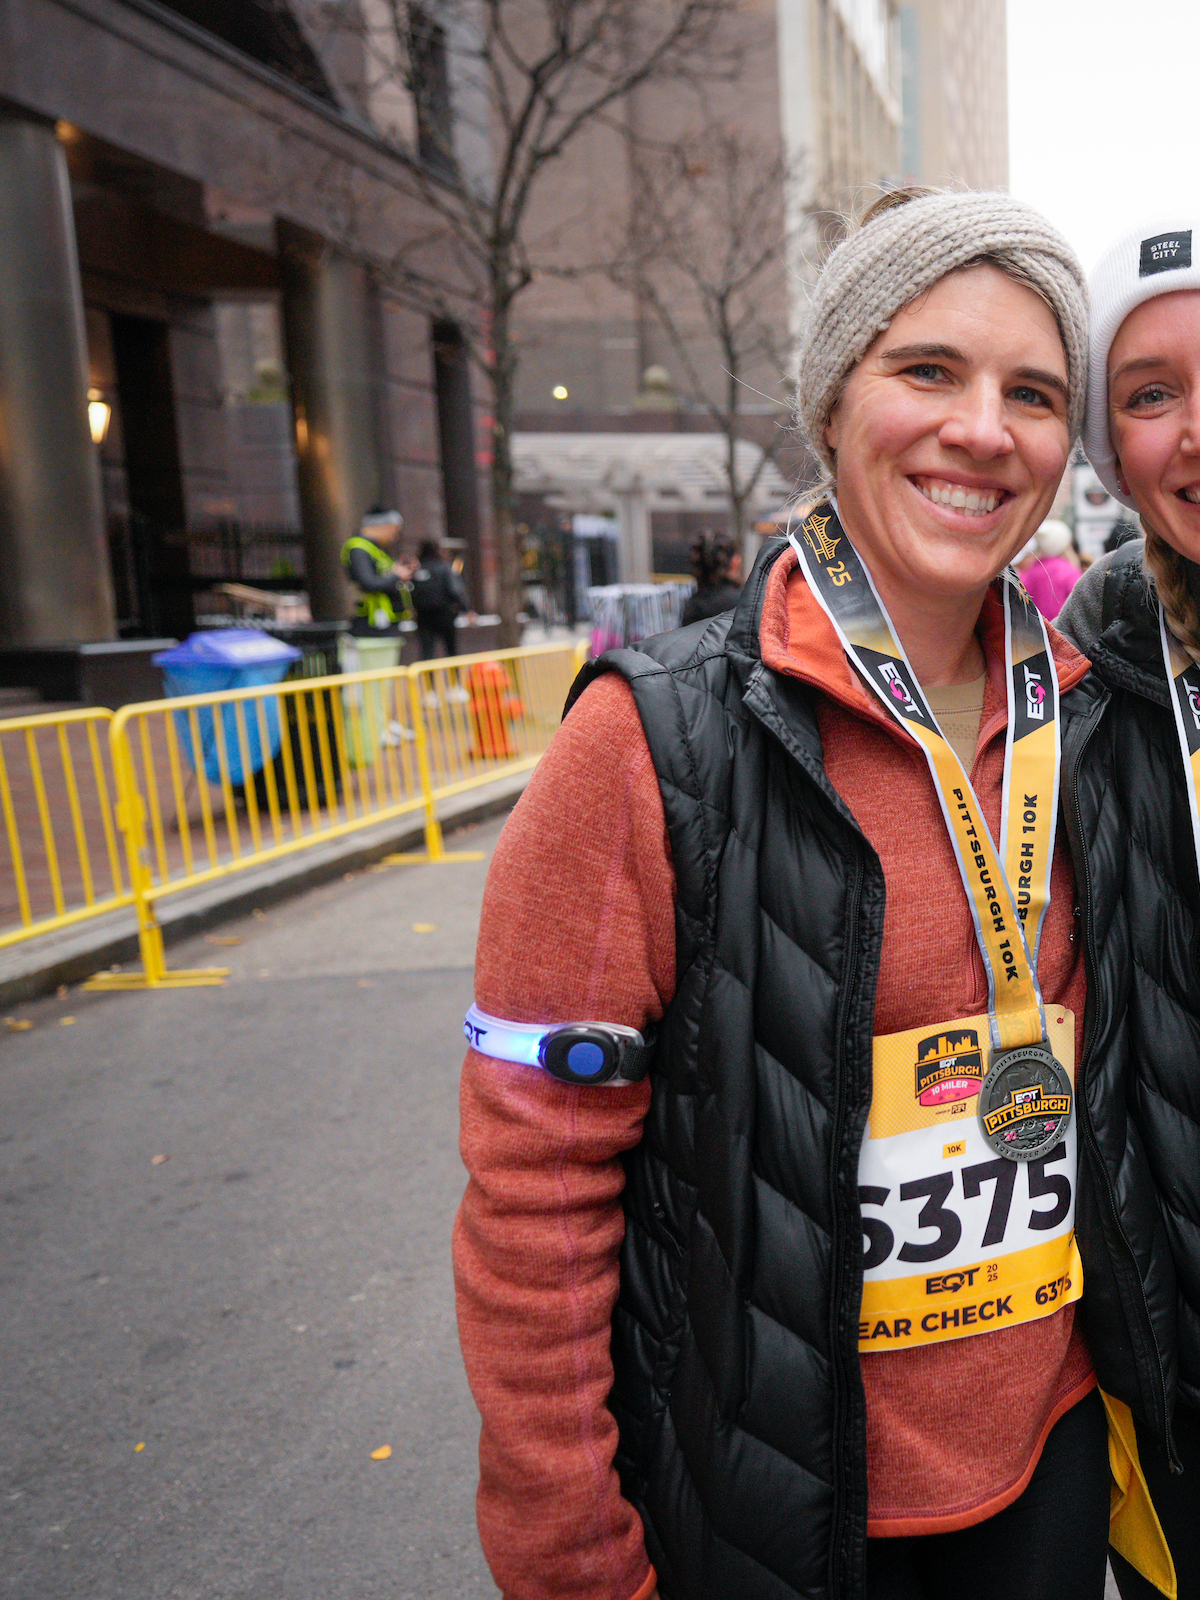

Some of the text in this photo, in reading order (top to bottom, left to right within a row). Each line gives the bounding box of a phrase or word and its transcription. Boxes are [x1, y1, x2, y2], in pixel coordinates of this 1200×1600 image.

[1150, 240, 1180, 253] STEEL
[1152, 248, 1177, 260] CITY
[826, 561, 852, 587] 25
[877, 661, 925, 719] EQT
[1023, 663, 1046, 720] EQT
[1017, 794, 1038, 932] BURGH 10K
[953, 788, 1019, 981] PITTSBURGH 10K
[463, 1020, 487, 1047] QT
[920, 1065, 980, 1088] PITTSBURGH
[931, 1080, 968, 1096] 10 MILER
[1014, 1089, 1039, 1103] EQT
[988, 1099, 1067, 1129] PITTSBURGH
[1044, 1121, 1055, 1131] 25
[1005, 1131, 1017, 1141] 20
[947, 1145, 962, 1154] 10K
[858, 1141, 1071, 1270] 6375
[987, 1263, 998, 1273] 20
[987, 1273, 998, 1283] 25
[926, 1267, 981, 1295] EQT
[858, 1272, 1072, 1340] EAR CHECK 6375
